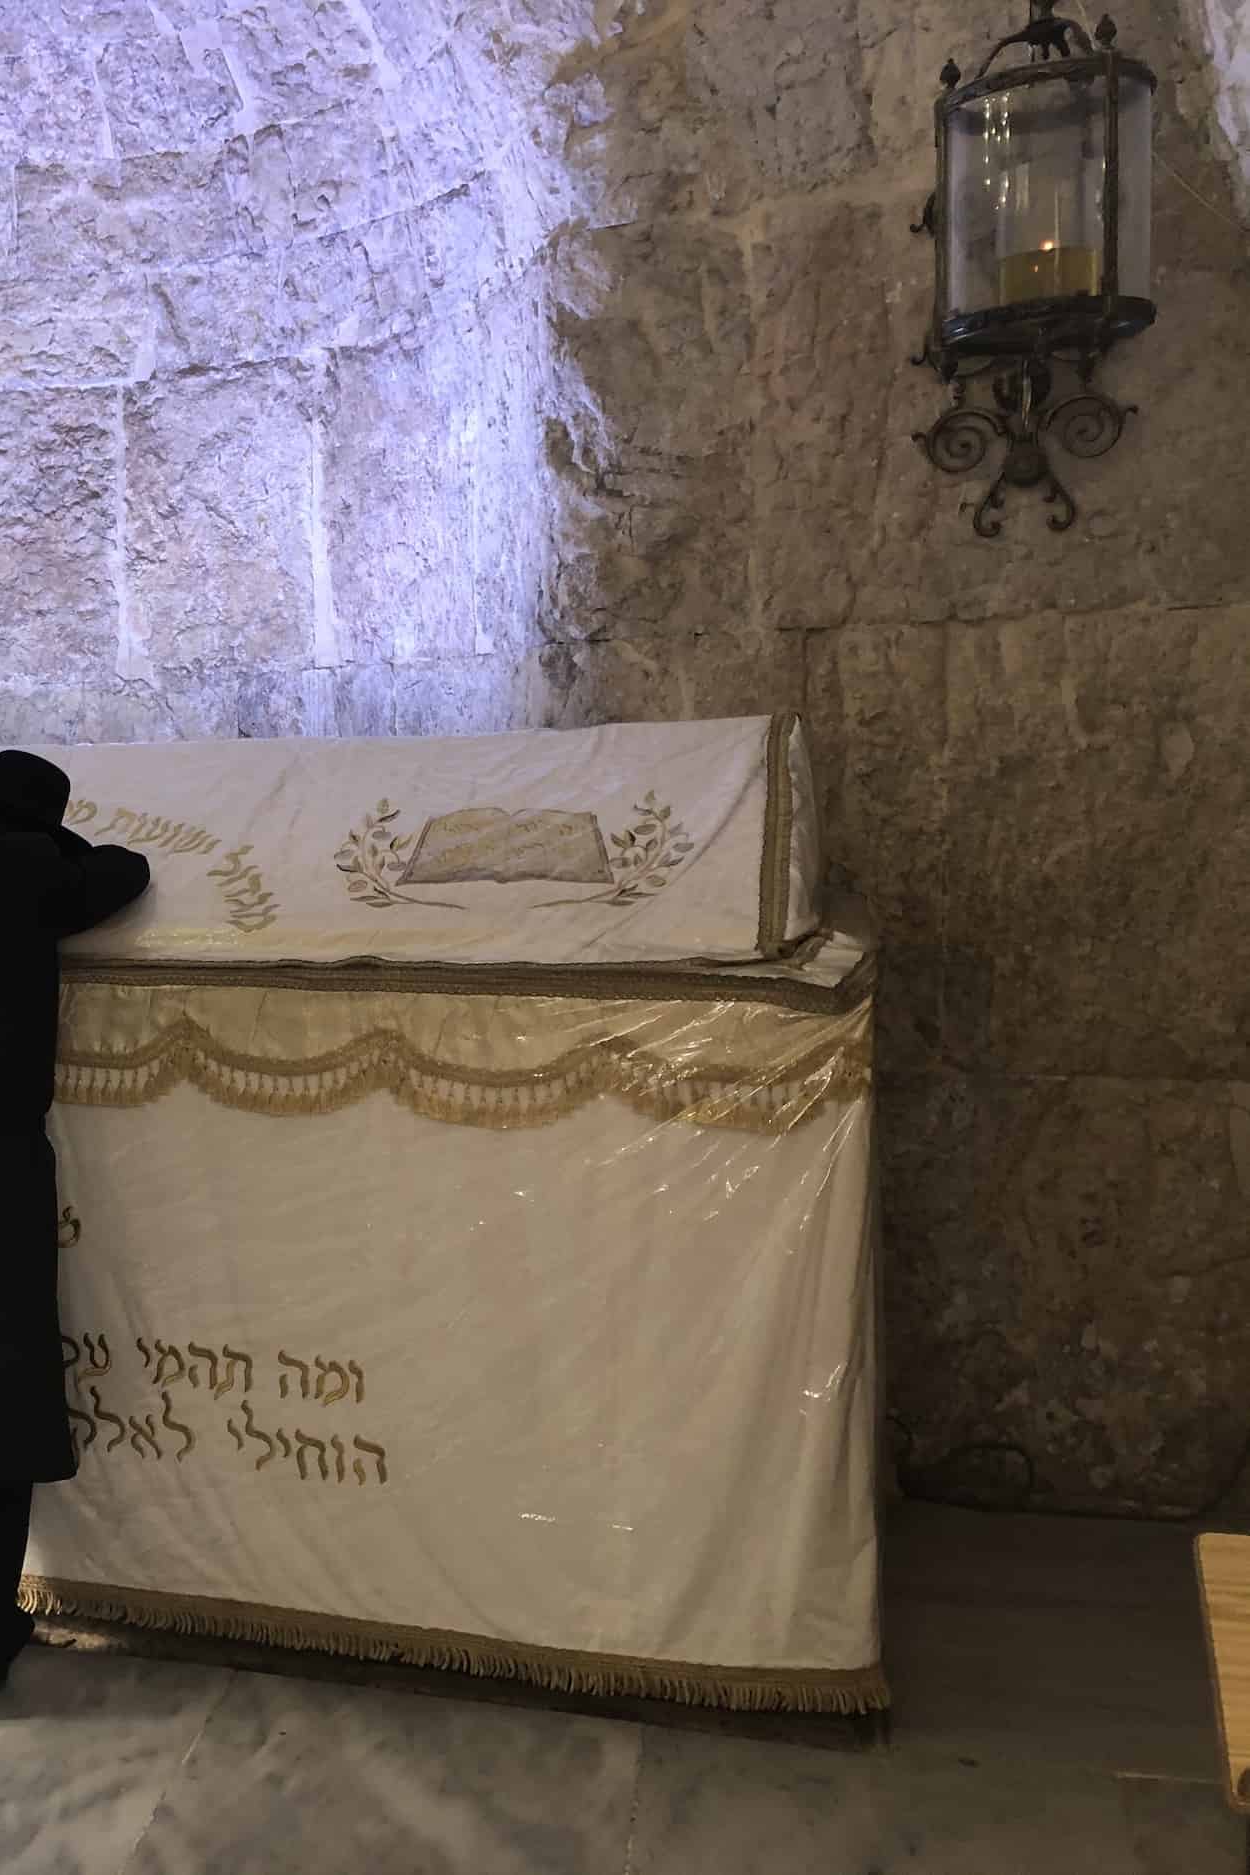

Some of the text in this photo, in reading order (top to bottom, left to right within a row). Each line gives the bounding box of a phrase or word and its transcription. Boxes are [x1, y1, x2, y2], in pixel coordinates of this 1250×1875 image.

[136, 1336, 254, 1400] תהמי
[277, 1349, 366, 1407] ומה
[227, 1399, 388, 1485] הוחילי
